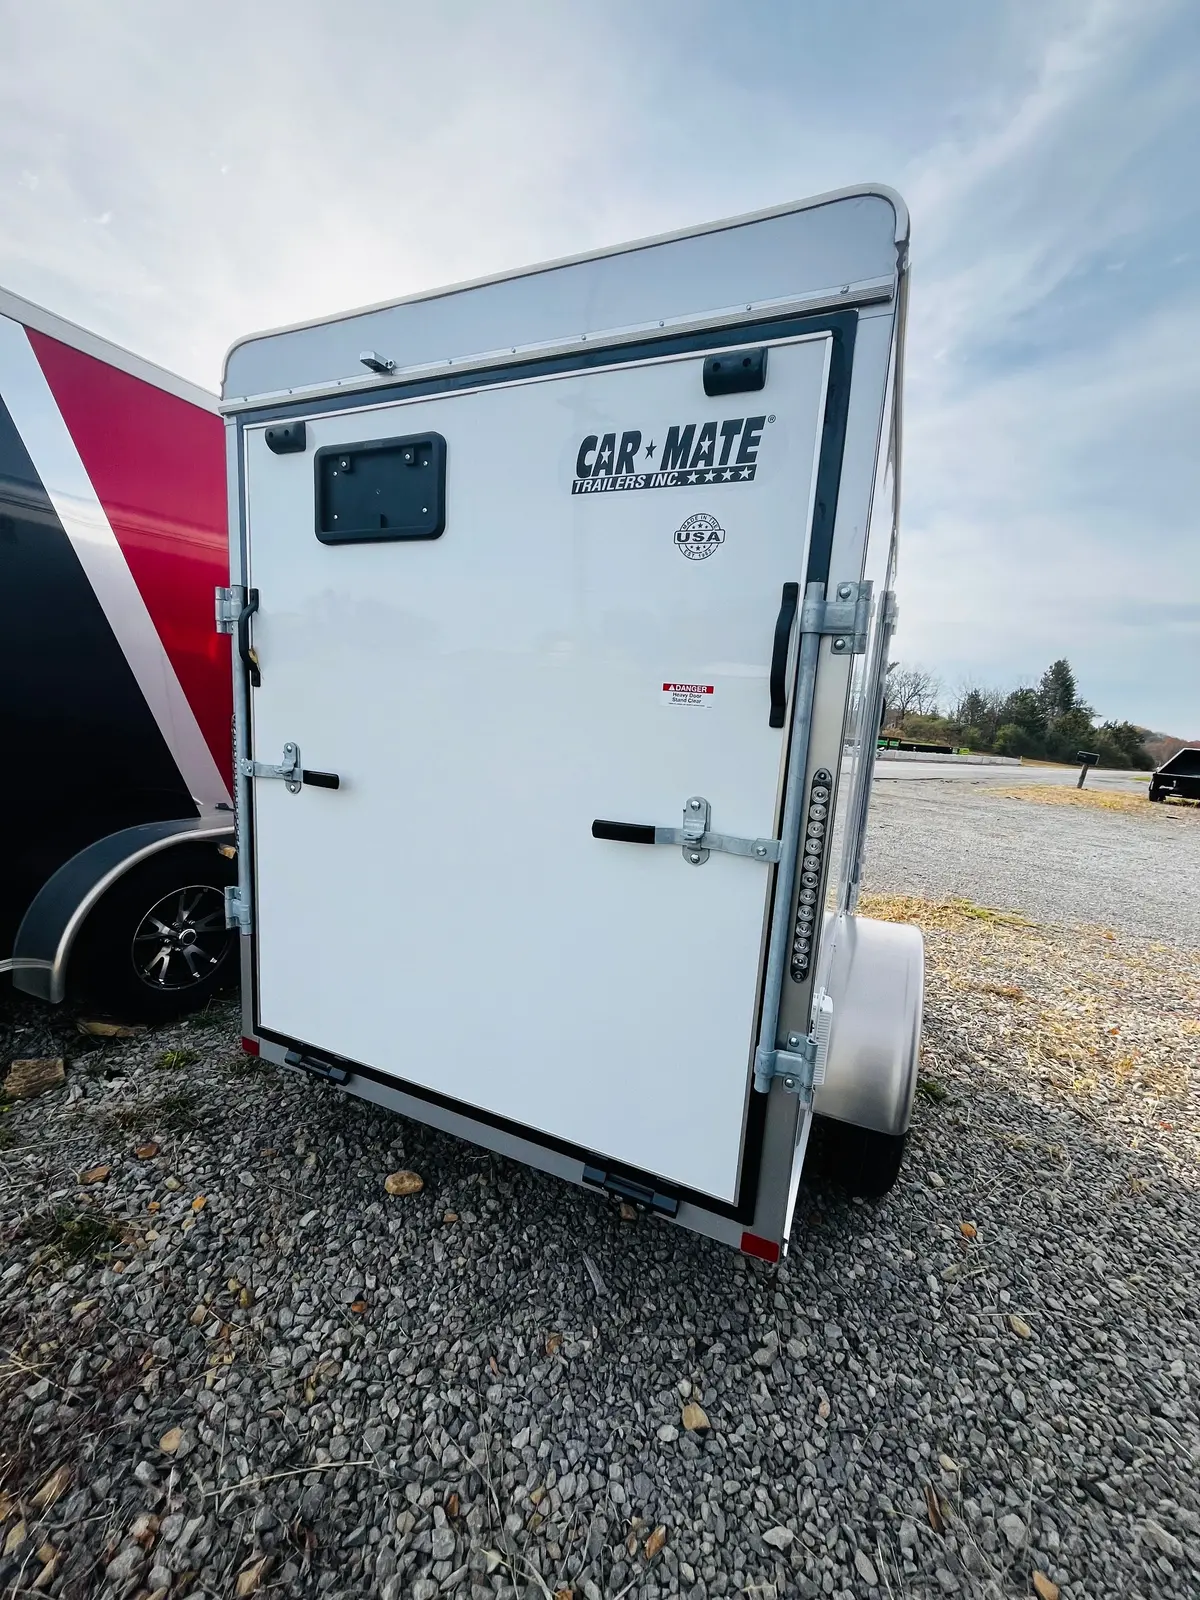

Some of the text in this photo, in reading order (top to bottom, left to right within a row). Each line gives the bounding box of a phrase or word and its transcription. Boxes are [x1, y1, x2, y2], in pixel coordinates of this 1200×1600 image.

[575, 415, 767, 479] CAR MATE
[574, 471, 682, 494] TRAILERS INC.
[683, 515, 698, 529] MADE
[677, 532, 720, 542] USA
